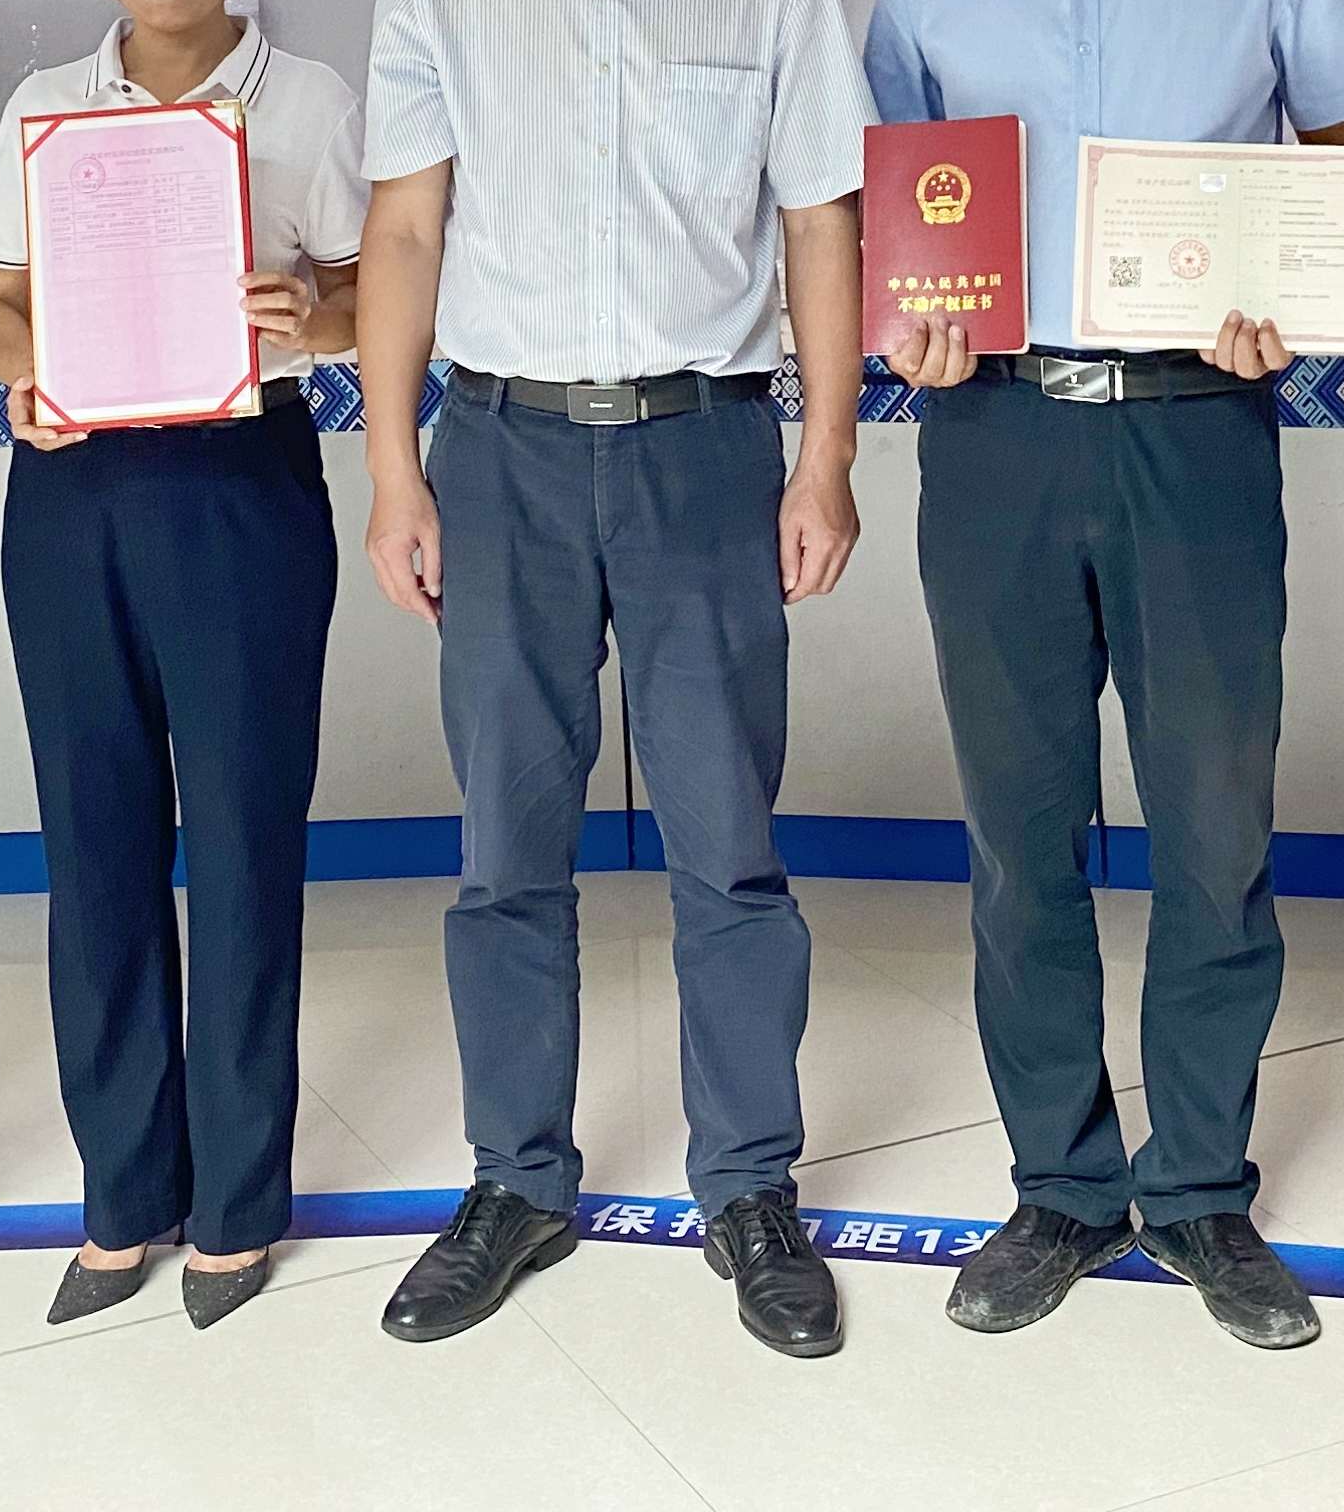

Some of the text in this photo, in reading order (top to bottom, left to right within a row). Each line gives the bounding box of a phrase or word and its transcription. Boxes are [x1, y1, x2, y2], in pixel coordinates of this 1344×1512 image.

[887, 273, 1003, 292] 中华人民共和国
[897, 293, 993, 314] 不动产权证书
[591, 1202, 998, 1257] 保持距1米
